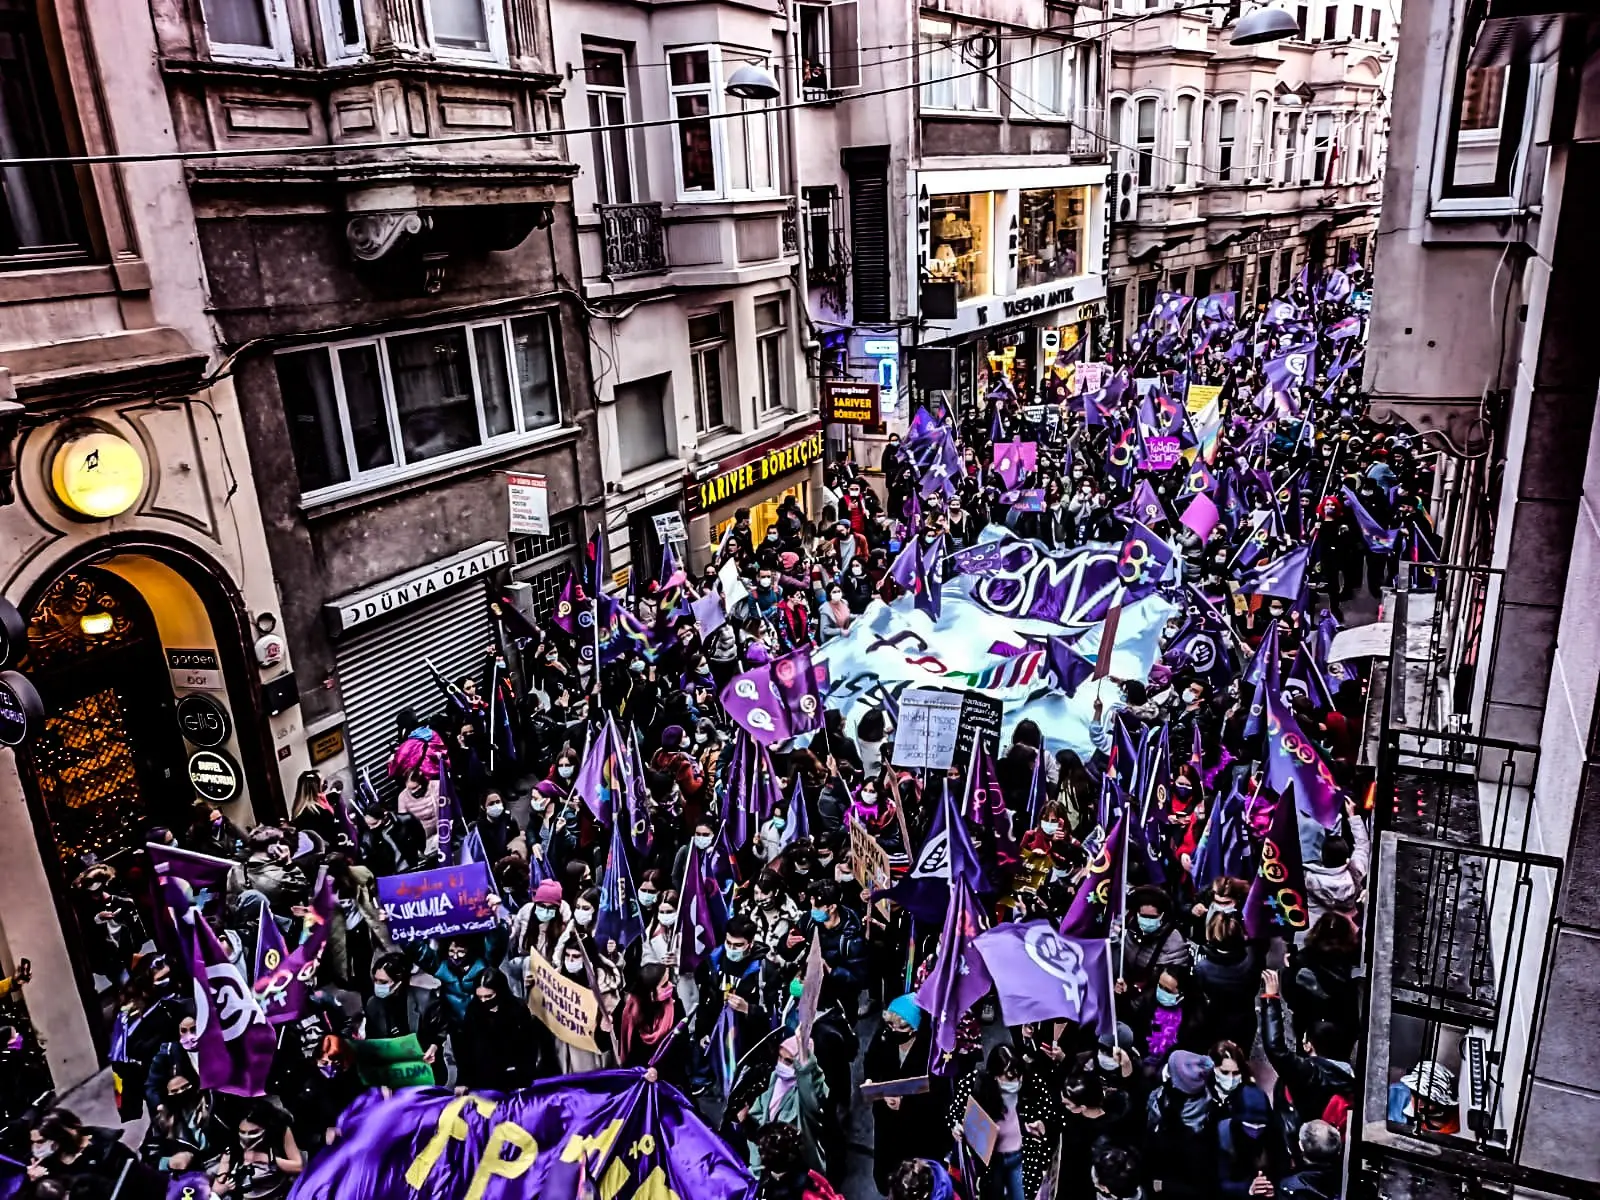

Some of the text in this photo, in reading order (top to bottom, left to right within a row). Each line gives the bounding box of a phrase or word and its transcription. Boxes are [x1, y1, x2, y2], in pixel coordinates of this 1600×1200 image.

[1009, 214, 1018, 269] ART
[834, 397, 872, 408] SARIYER
[701, 465, 754, 508] SARIYER
[365, 548, 508, 619] DÜNYA OZALİT
[384, 893, 454, 921] KUKUMLA
